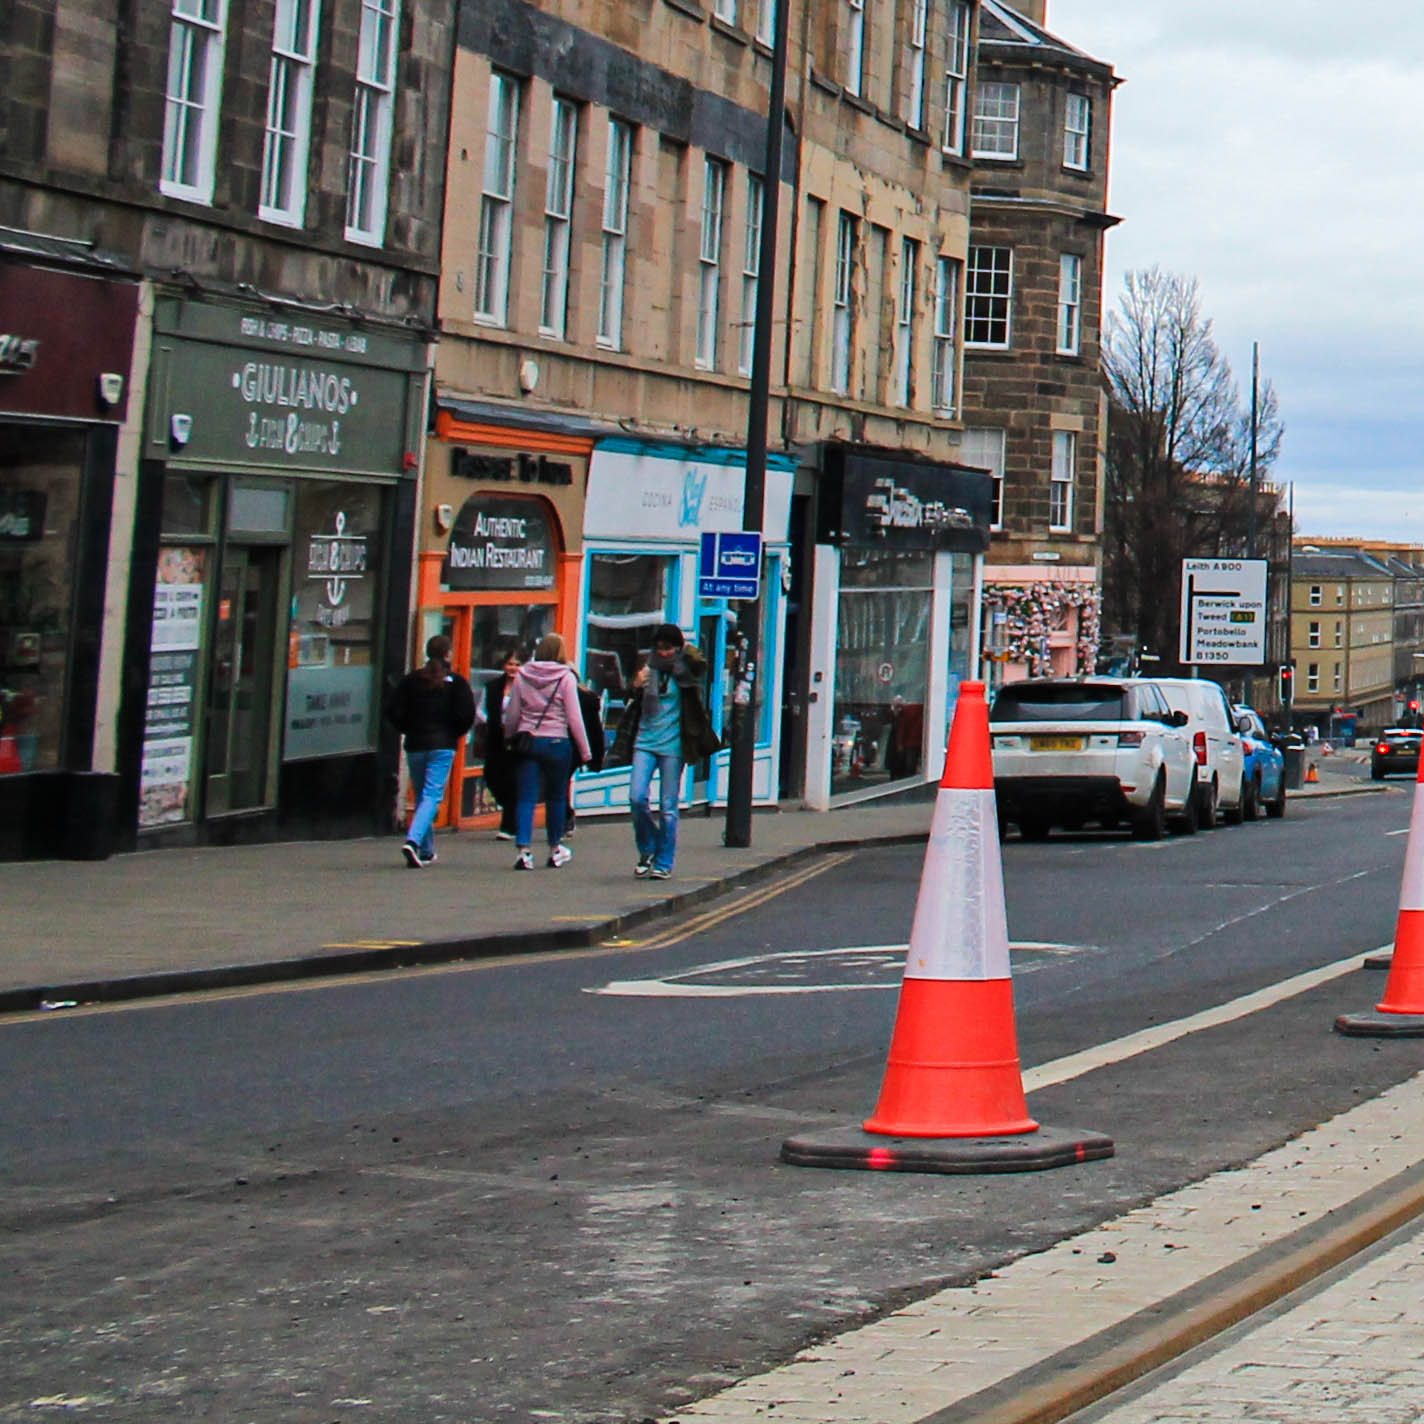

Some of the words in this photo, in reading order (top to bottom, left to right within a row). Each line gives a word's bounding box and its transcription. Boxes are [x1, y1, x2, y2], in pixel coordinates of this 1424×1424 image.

[293, 326, 313, 345] PIZZA
[317, 330, 340, 349] PASTA
[241, 362, 350, 414] GIULIANOS
[473, 512, 526, 538] AUTHENTIC
[451, 542, 485, 568] INDIAN
[486, 543, 545, 569] RESTAURANT
[1186, 563, 1210, 571] Leith
[703, 581, 714, 592] At
[716, 584, 731, 594] any
[734, 582, 754, 593] time
[1198, 600, 1235, 609] Berwick
[1239, 602, 1263, 610] upon
[1198, 613, 1228, 621] Tweed
[1197, 627, 1247, 636] Portobello
[1196, 639, 1258, 649] Meadowbank
